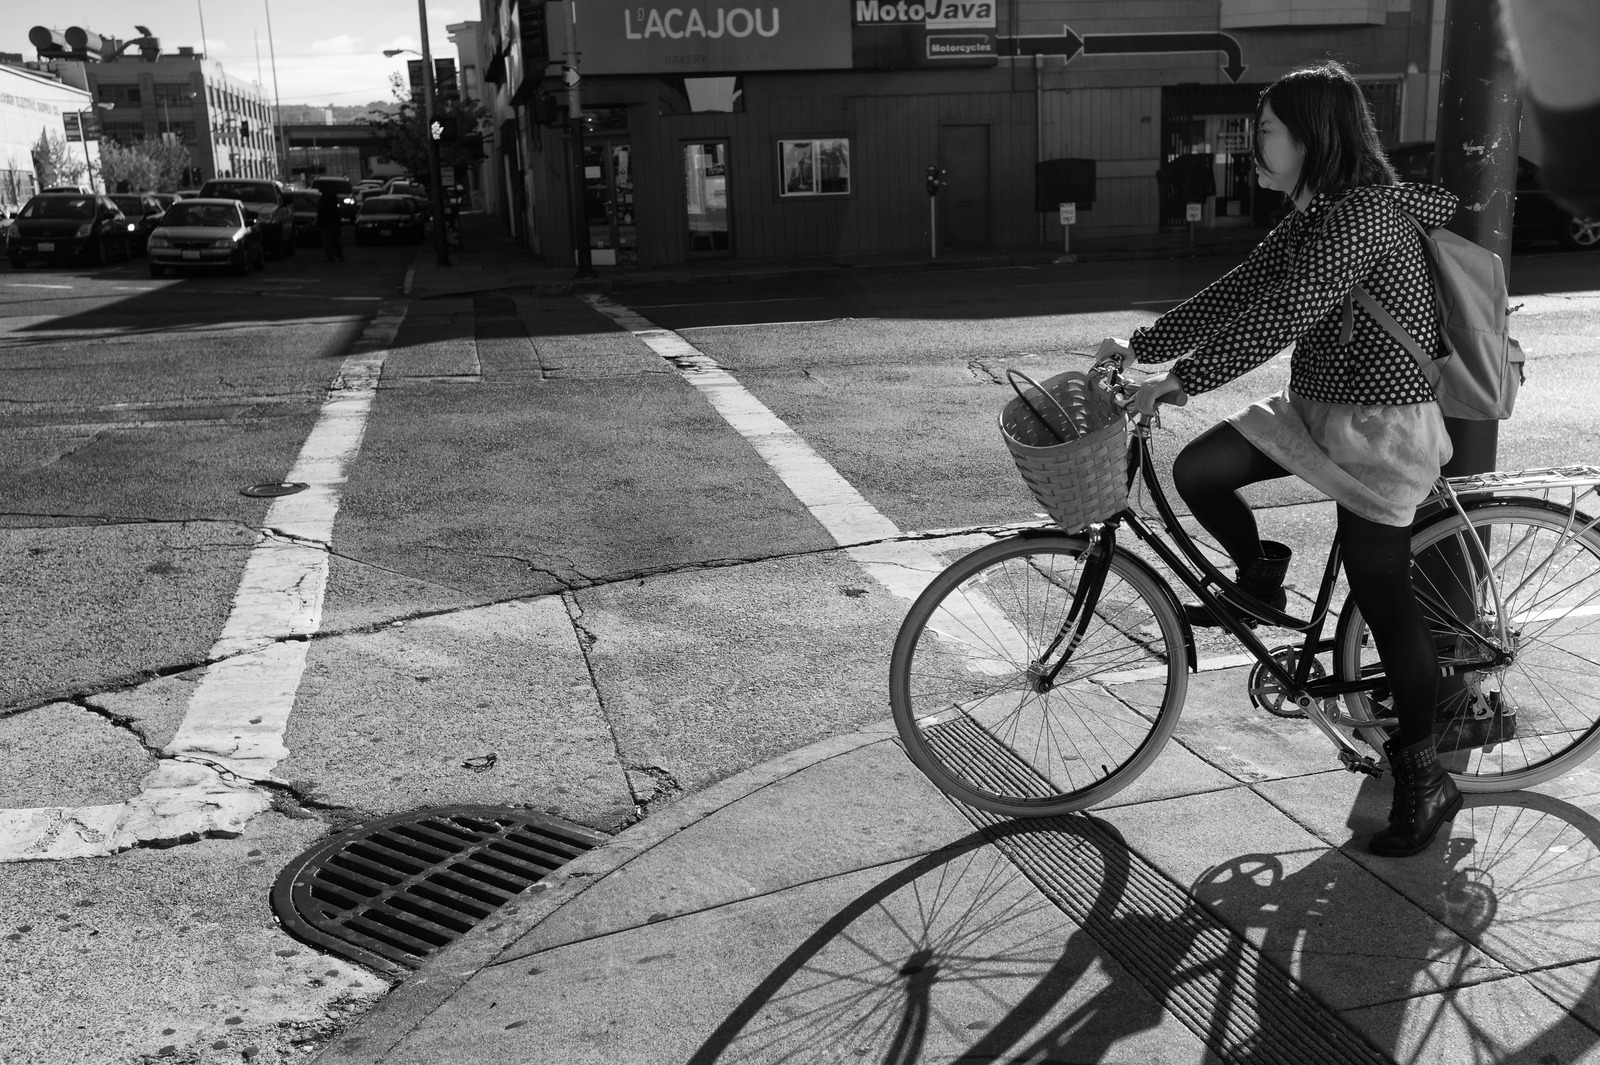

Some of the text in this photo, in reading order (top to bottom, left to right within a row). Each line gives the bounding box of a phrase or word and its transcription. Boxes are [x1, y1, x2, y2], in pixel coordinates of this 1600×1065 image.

[625, 7, 779, 40] L'ACAJOU
[931, 43, 992, 53] Motorcycles
[664, 54, 706, 65] BAKERY
